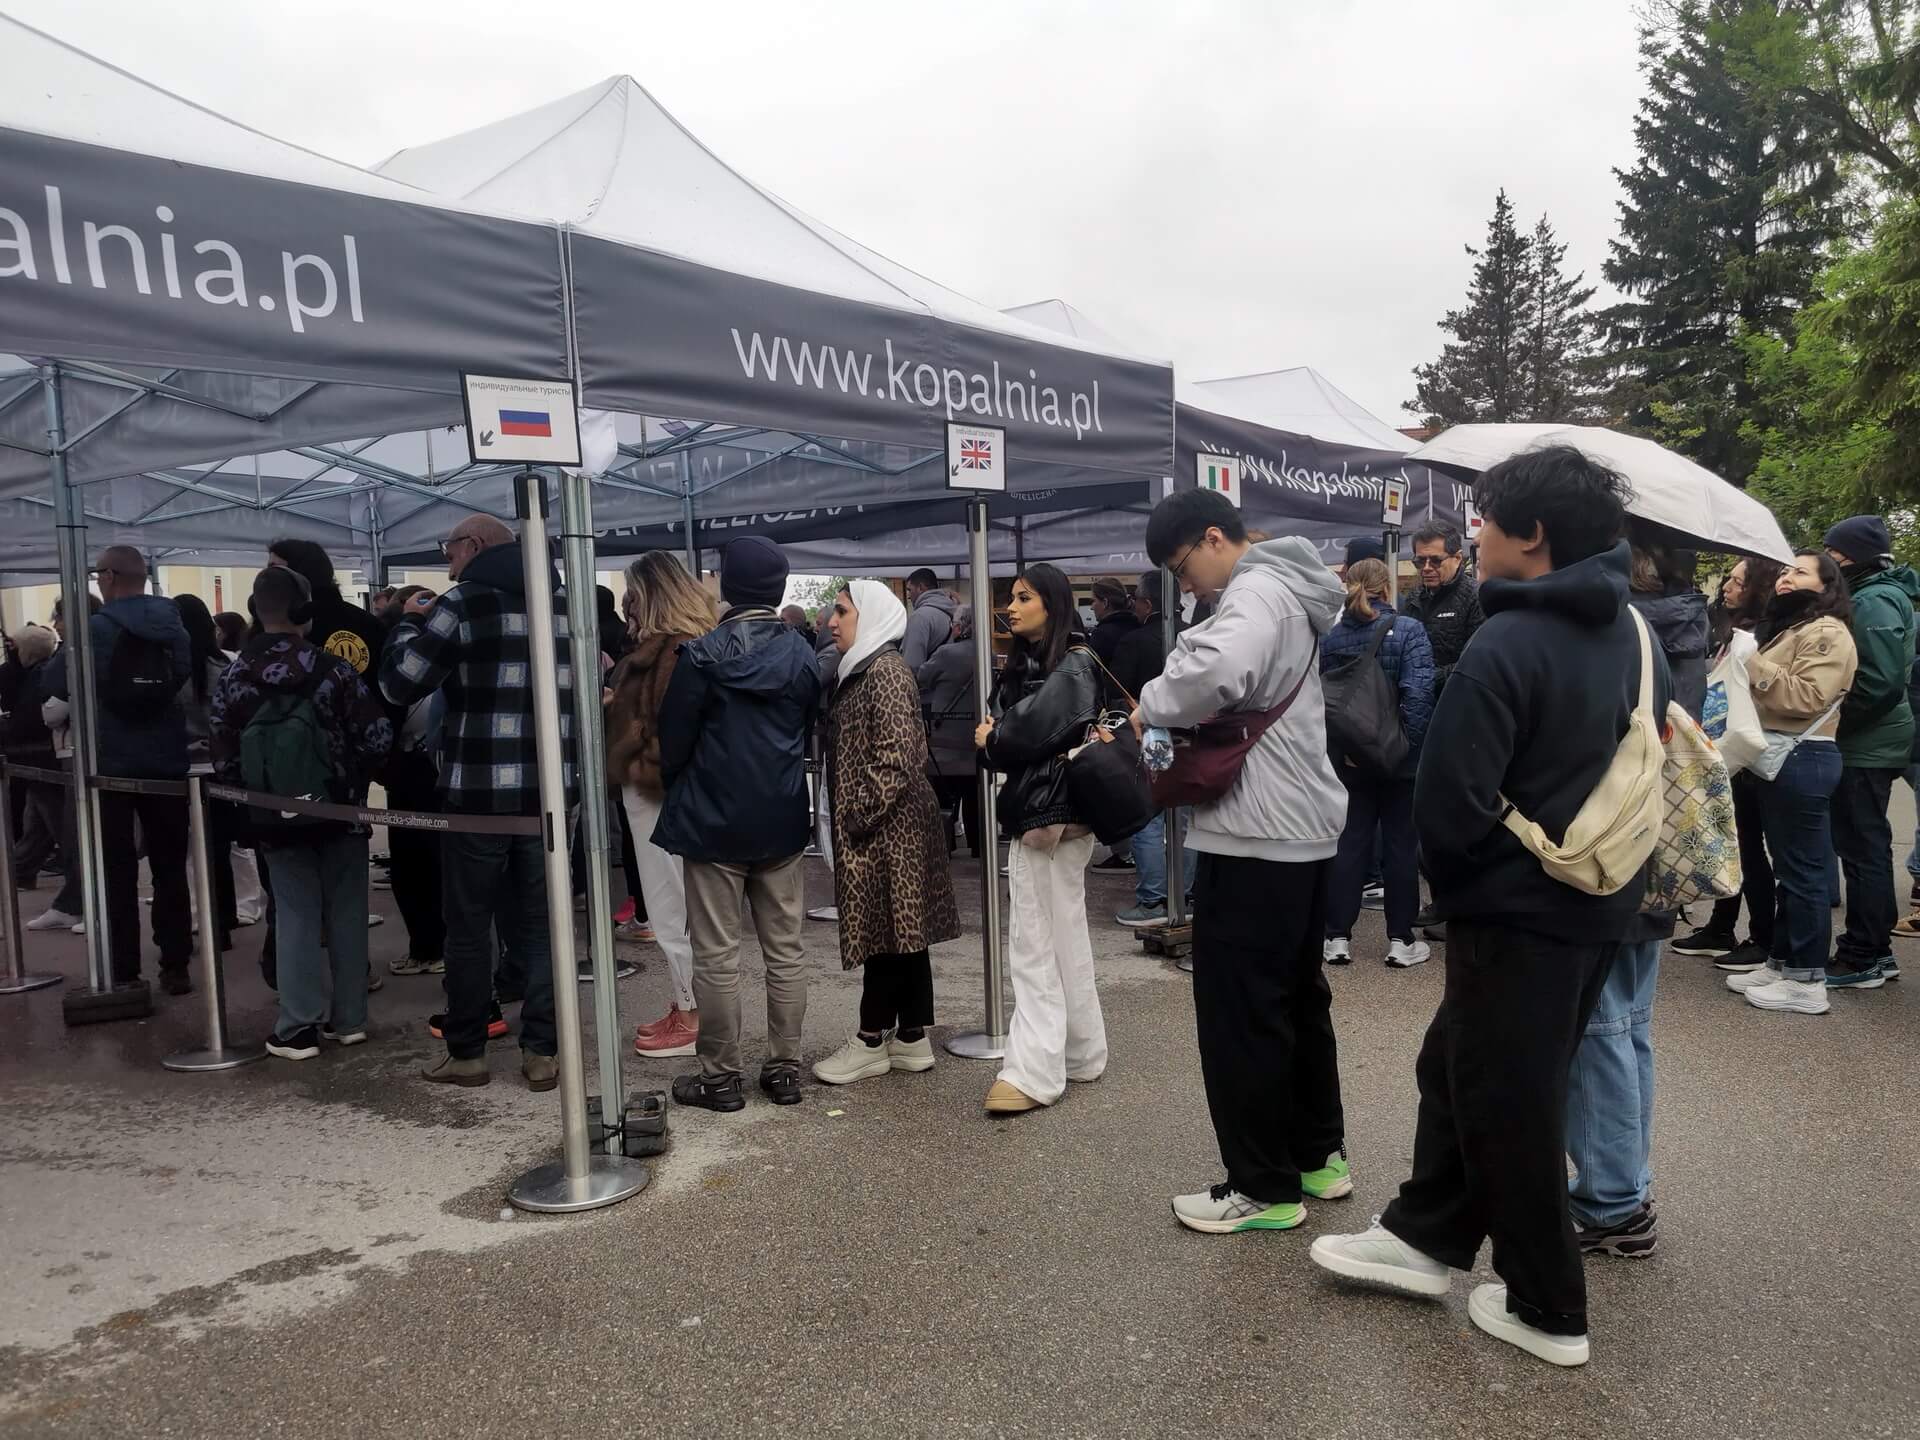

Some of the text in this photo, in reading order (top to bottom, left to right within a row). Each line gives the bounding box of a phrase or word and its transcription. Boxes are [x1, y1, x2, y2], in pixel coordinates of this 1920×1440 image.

[540, 386, 571, 396] туристы
[731, 328, 1103, 440] www.kopalnia.pl
[358, 812, 449, 829] www.wieliczka-saltmine.com
